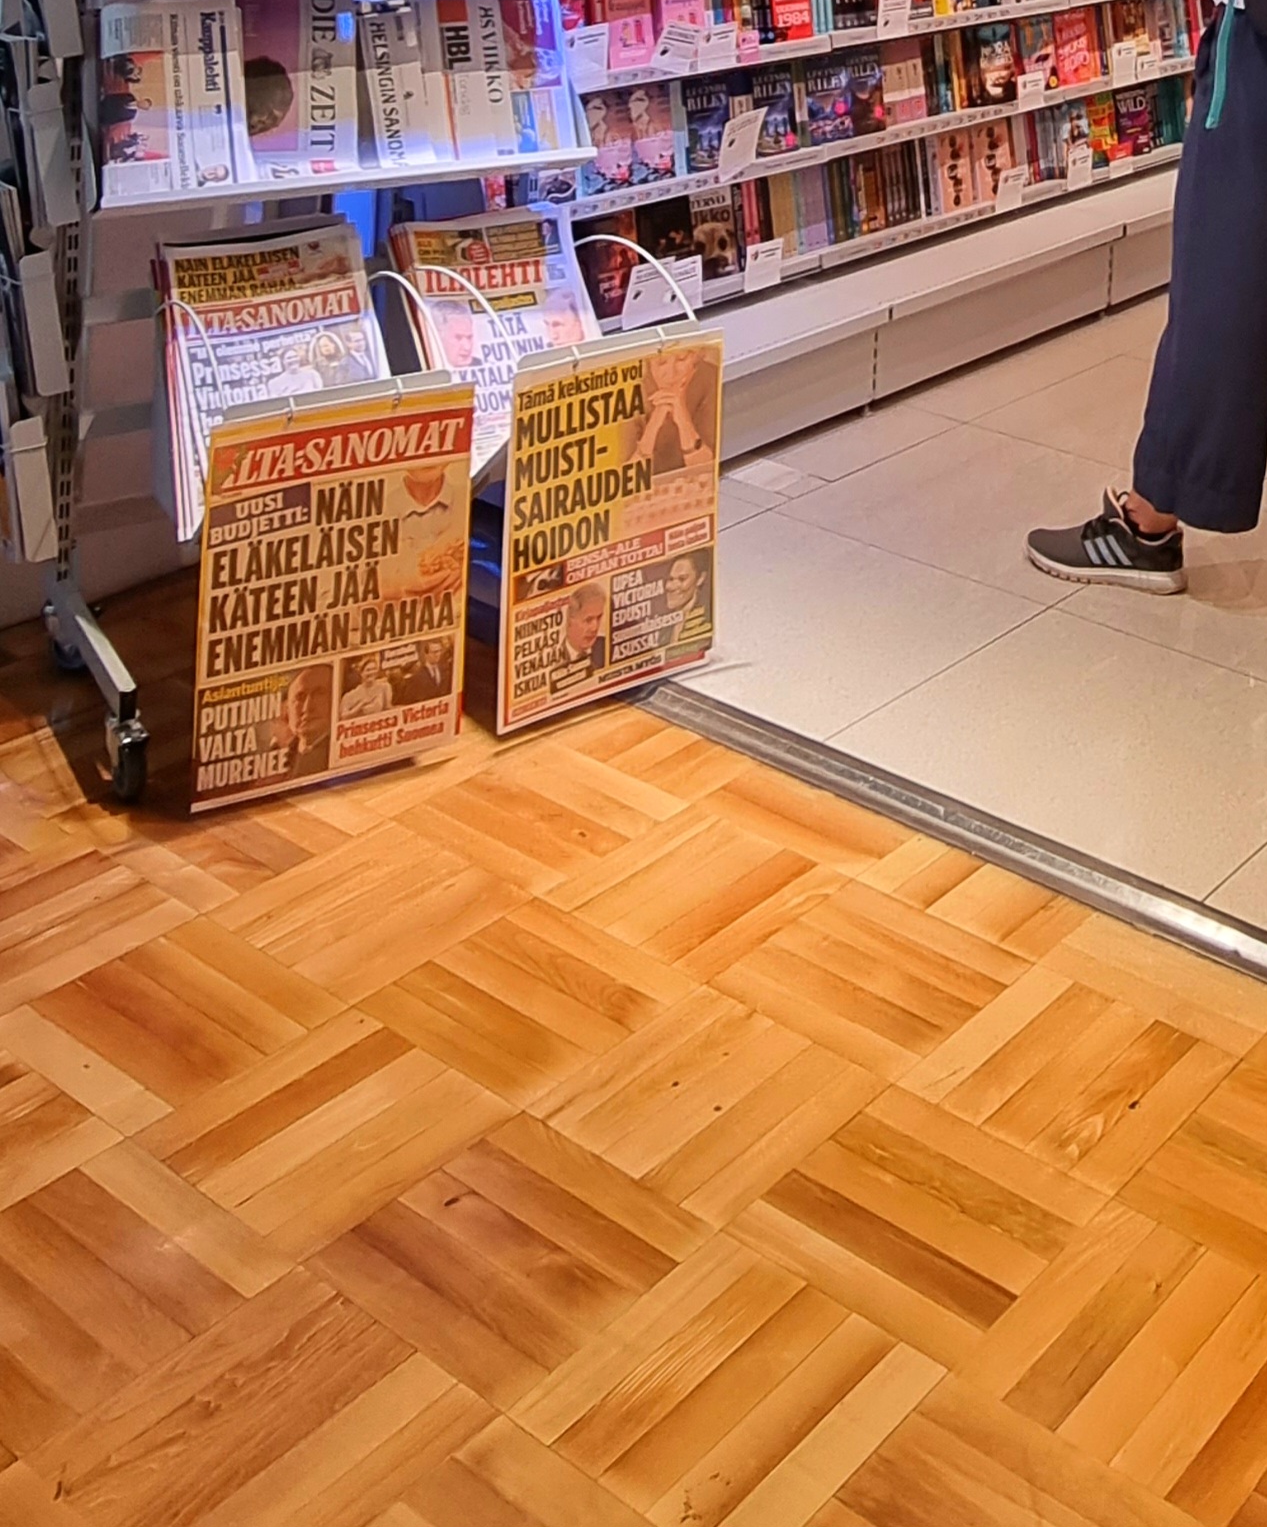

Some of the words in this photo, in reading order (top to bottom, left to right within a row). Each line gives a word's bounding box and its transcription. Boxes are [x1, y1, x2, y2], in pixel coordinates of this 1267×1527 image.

[777, 10, 811, 28] 1984
[369, 21, 398, 102] HELSINGIN
[445, 26, 472, 70] HBL
[482, 33, 504, 104] VIIKKO
[310, 85, 336, 152] ZEIT
[1117, 96, 1146, 114] WILD
[192, 355, 283, 386] Prnsessa
[481, 335, 544, 364] PUTNIN
[517, 383, 554, 413] Tämä
[558, 367, 619, 401] keksintö
[622, 359, 643, 381] voi
[516, 383, 646, 451] MULLISTAA
[515, 435, 609, 491] MUISTI-
[236, 492, 284, 520] UUSI
[315, 477, 385, 526] NÄIN
[514, 458, 652, 532] SAIRAUDEN
[209, 506, 310, 546] BUDJETTI:
[513, 509, 610, 572] HOIDON
[211, 517, 399, 590] ELÄKELÄISEN
[209, 575, 318, 634] KÄTEEN
[327, 560, 380, 609] JÄÄ
[612, 569, 643, 592] UPEA
[612, 579, 665, 609] VICTORIA
[207, 611, 350, 678] ENEMMÄN
[360, 591, 454, 645] RAHAA
[612, 601, 651, 627] EDUSTI
[514, 630, 560, 661] PELKÄSI
[514, 676, 547, 700] ISKUA
[201, 691, 283, 734] PUTININ
[336, 715, 398, 741] Prinsessa
[402, 700, 449, 724] Victoria
[200, 726, 257, 762] VALTA
[197, 747, 289, 792] MURENEE
